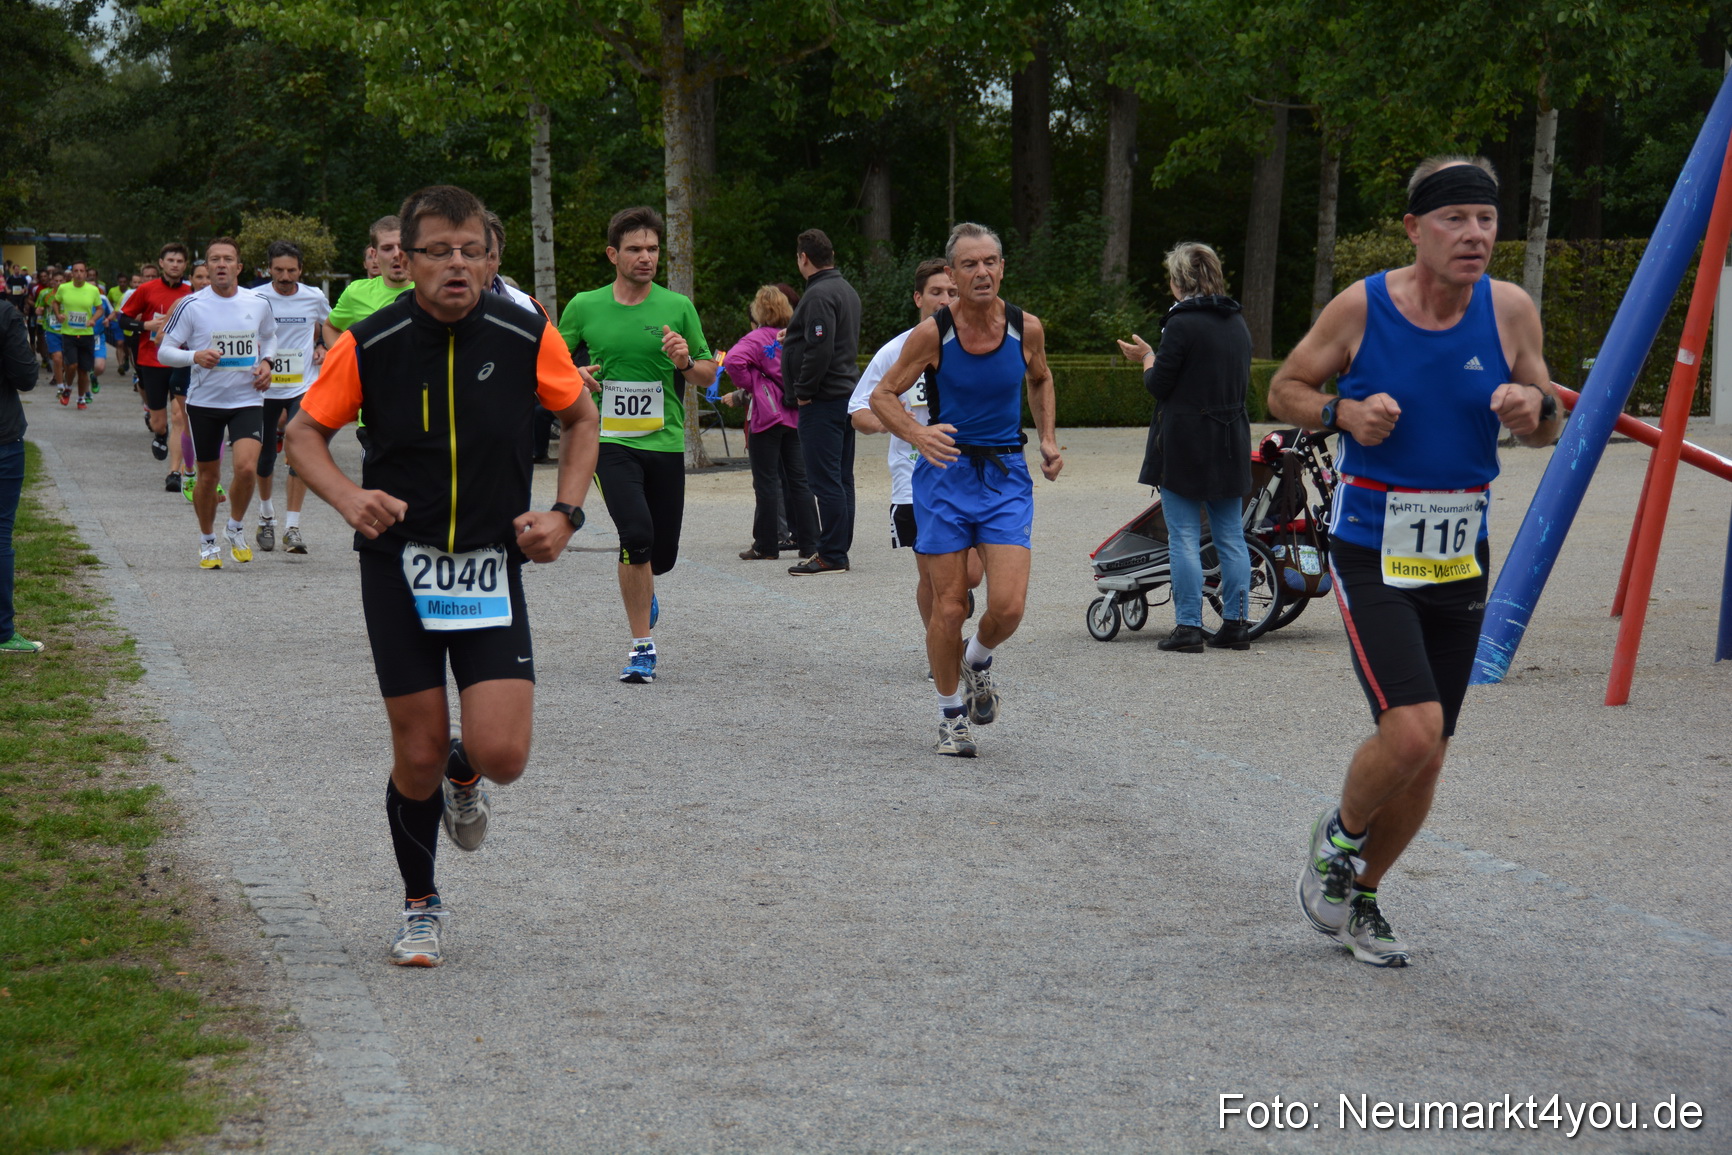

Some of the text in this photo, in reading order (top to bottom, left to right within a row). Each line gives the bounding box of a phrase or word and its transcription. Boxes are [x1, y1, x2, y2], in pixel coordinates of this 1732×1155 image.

[217, 340, 253, 356] 3106
[604, 385, 623, 393] PARTL
[614, 395, 652, 416] 502
[1429, 503, 1473, 514] Neumarkt
[1409, 517, 1469, 555] 116
[412, 553, 498, 593] 2040
[1391, 561, 1472, 579] Hans-Werner
[427, 600, 482, 616] Michael
